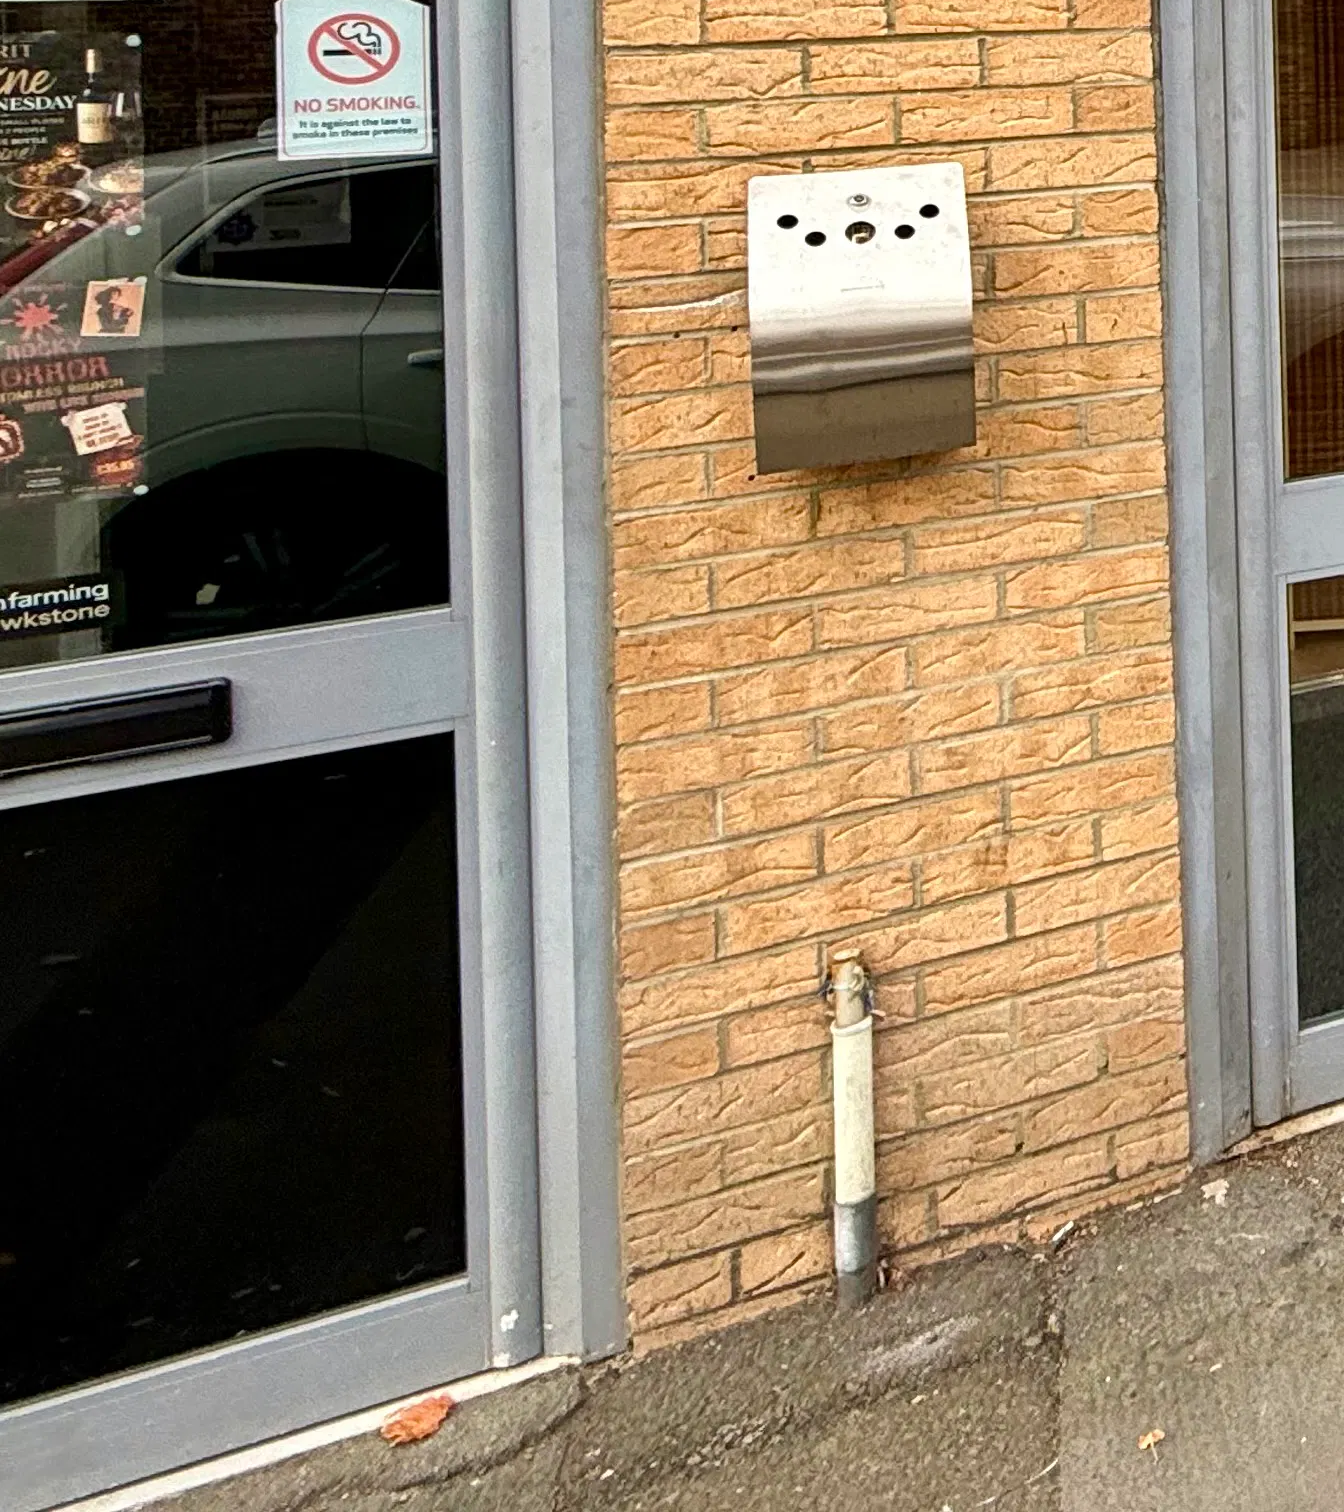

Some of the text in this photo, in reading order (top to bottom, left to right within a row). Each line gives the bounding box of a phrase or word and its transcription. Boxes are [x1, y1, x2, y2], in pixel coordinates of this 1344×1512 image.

[294, 98, 322, 114] NO
[321, 119, 359, 130] against
[362, 118, 378, 127] the
[381, 117, 398, 126] law
[401, 117, 411, 125] to
[292, 126, 419, 139] smoke in these premises
[8, 583, 110, 610] farming
